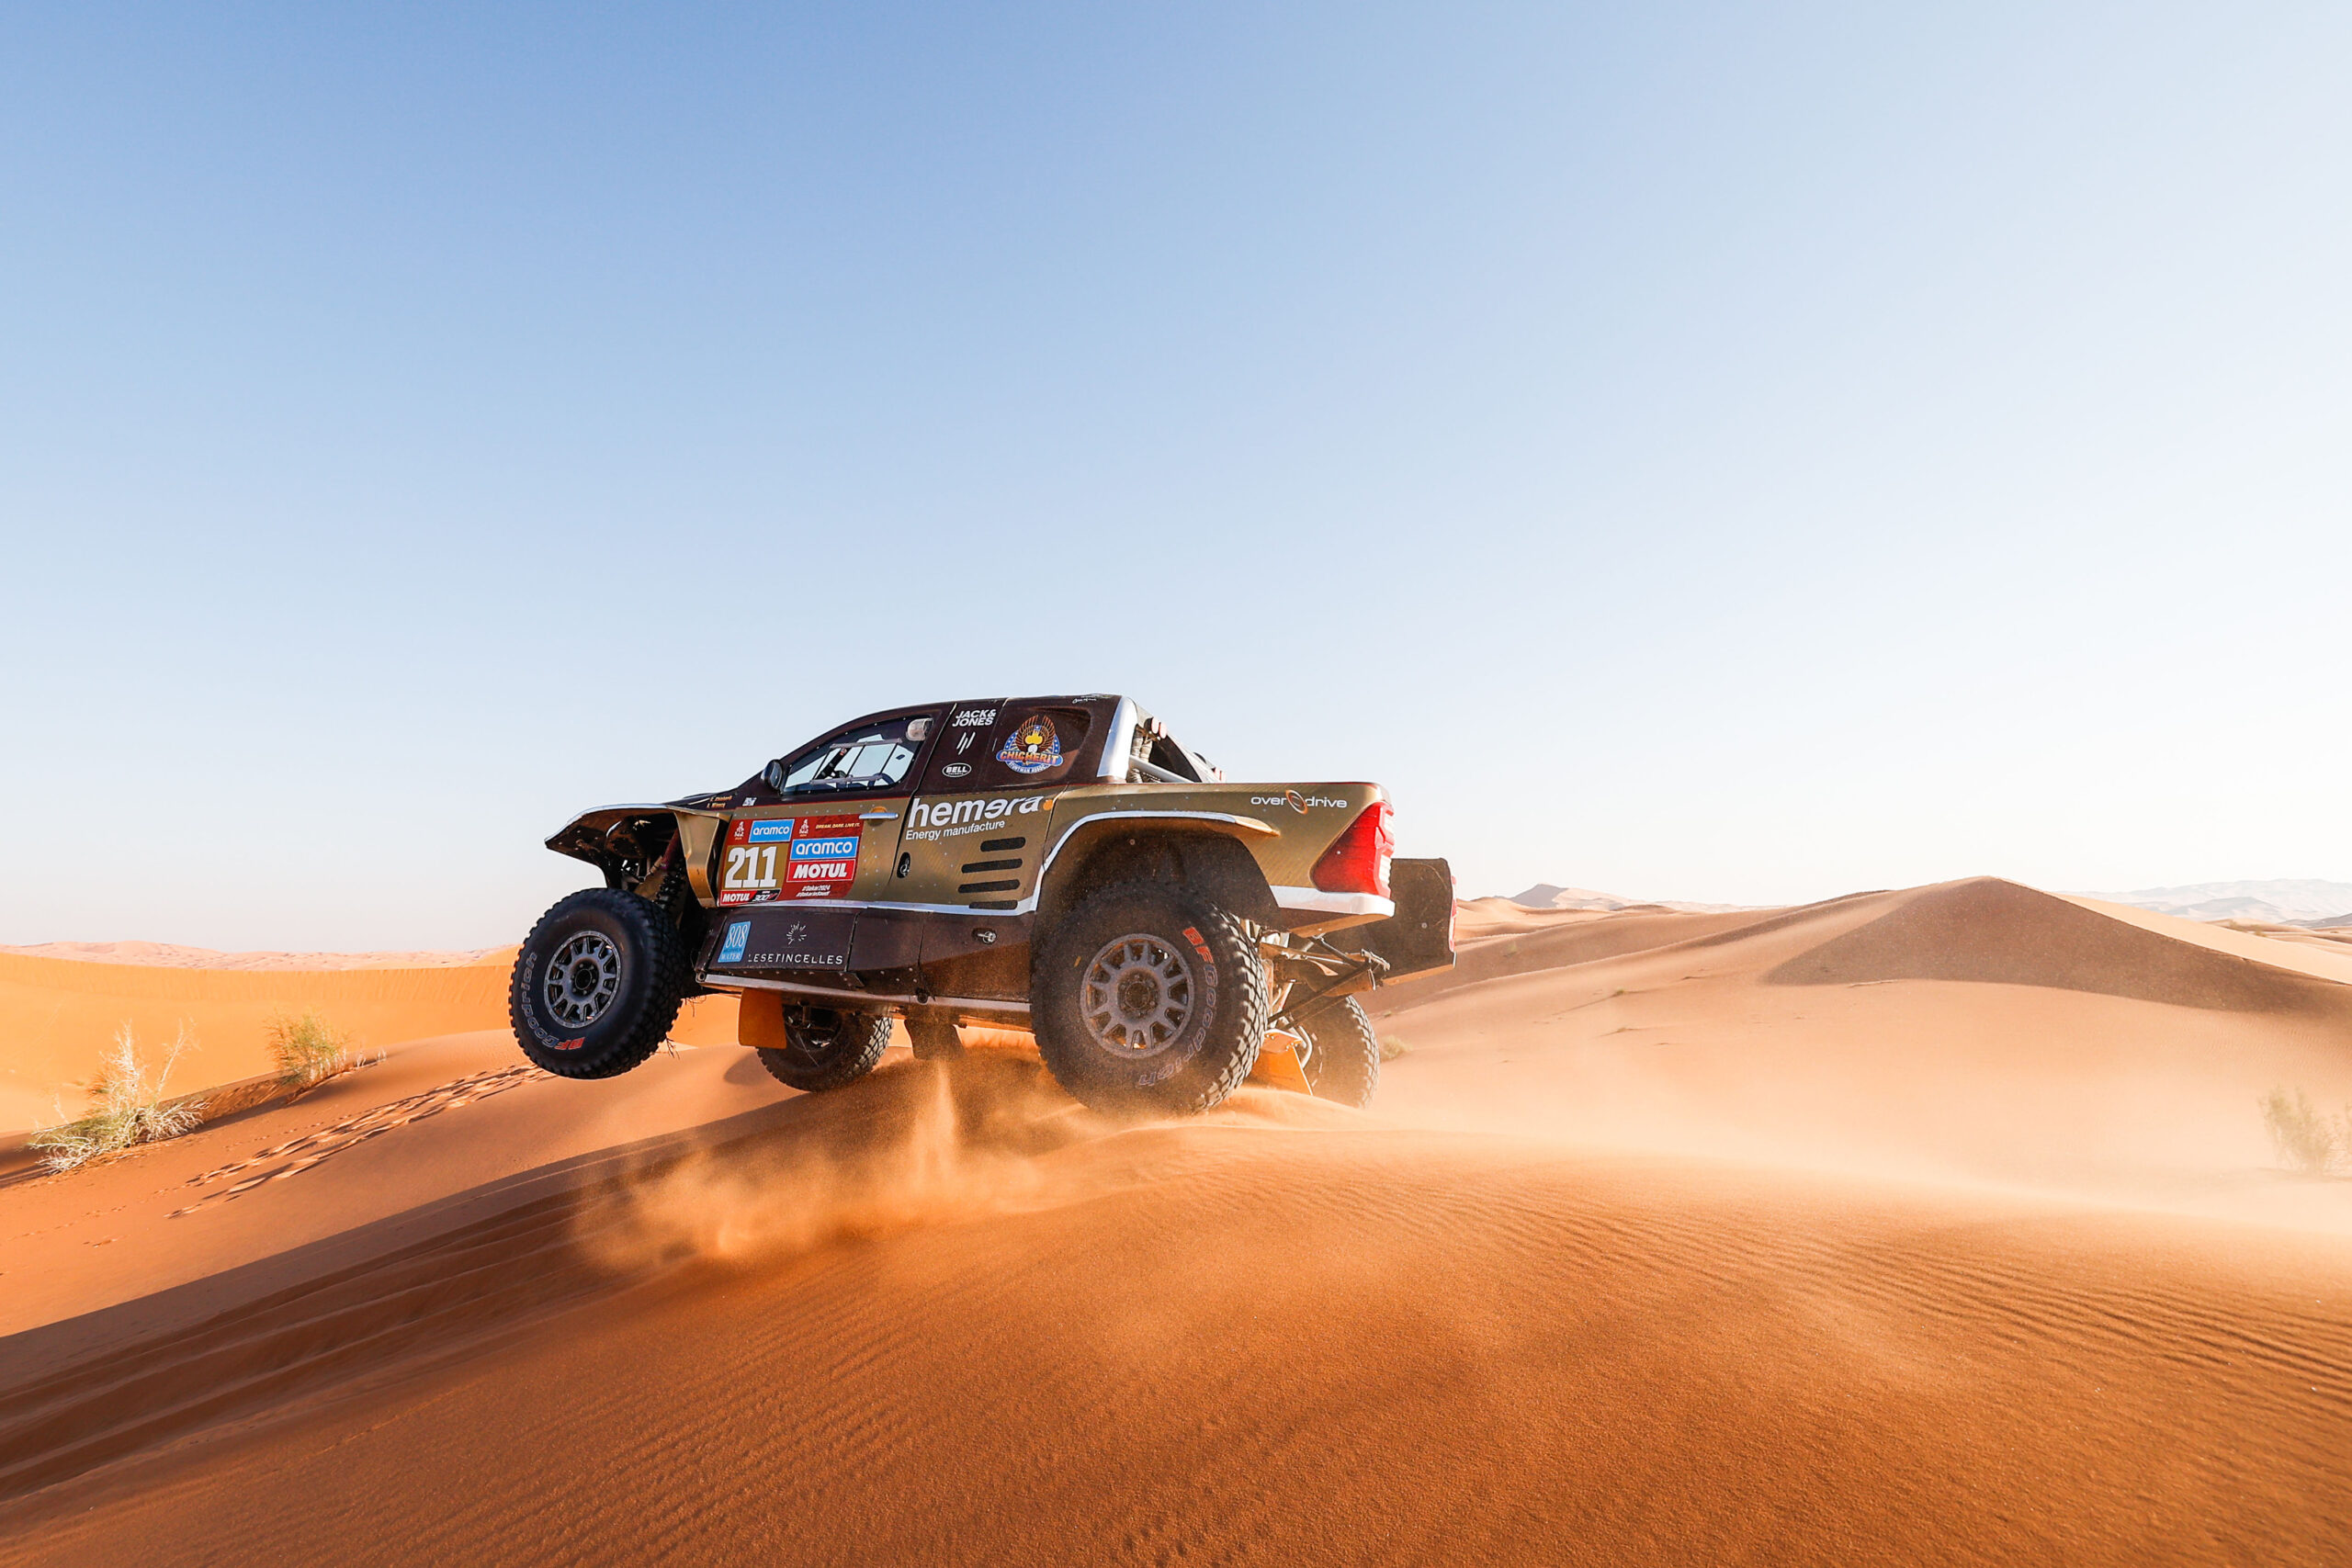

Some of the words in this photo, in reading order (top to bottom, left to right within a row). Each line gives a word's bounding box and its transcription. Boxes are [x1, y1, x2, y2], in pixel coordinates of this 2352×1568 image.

[956, 709, 997, 718] JACK&
[952, 717, 994, 727] JONES
[1000, 750, 1059, 764] CHICHERIT
[908, 795, 1044, 828] hemera
[753, 826, 790, 836] aramco
[905, 829, 941, 840] Energy
[943, 820, 1006, 837] manufacture
[796, 840, 853, 855] aramco
[724, 846, 777, 888] 211
[793, 863, 847, 879] MOTUL
[722, 893, 751, 902] MOTUL
[726, 924, 748, 948] 808
